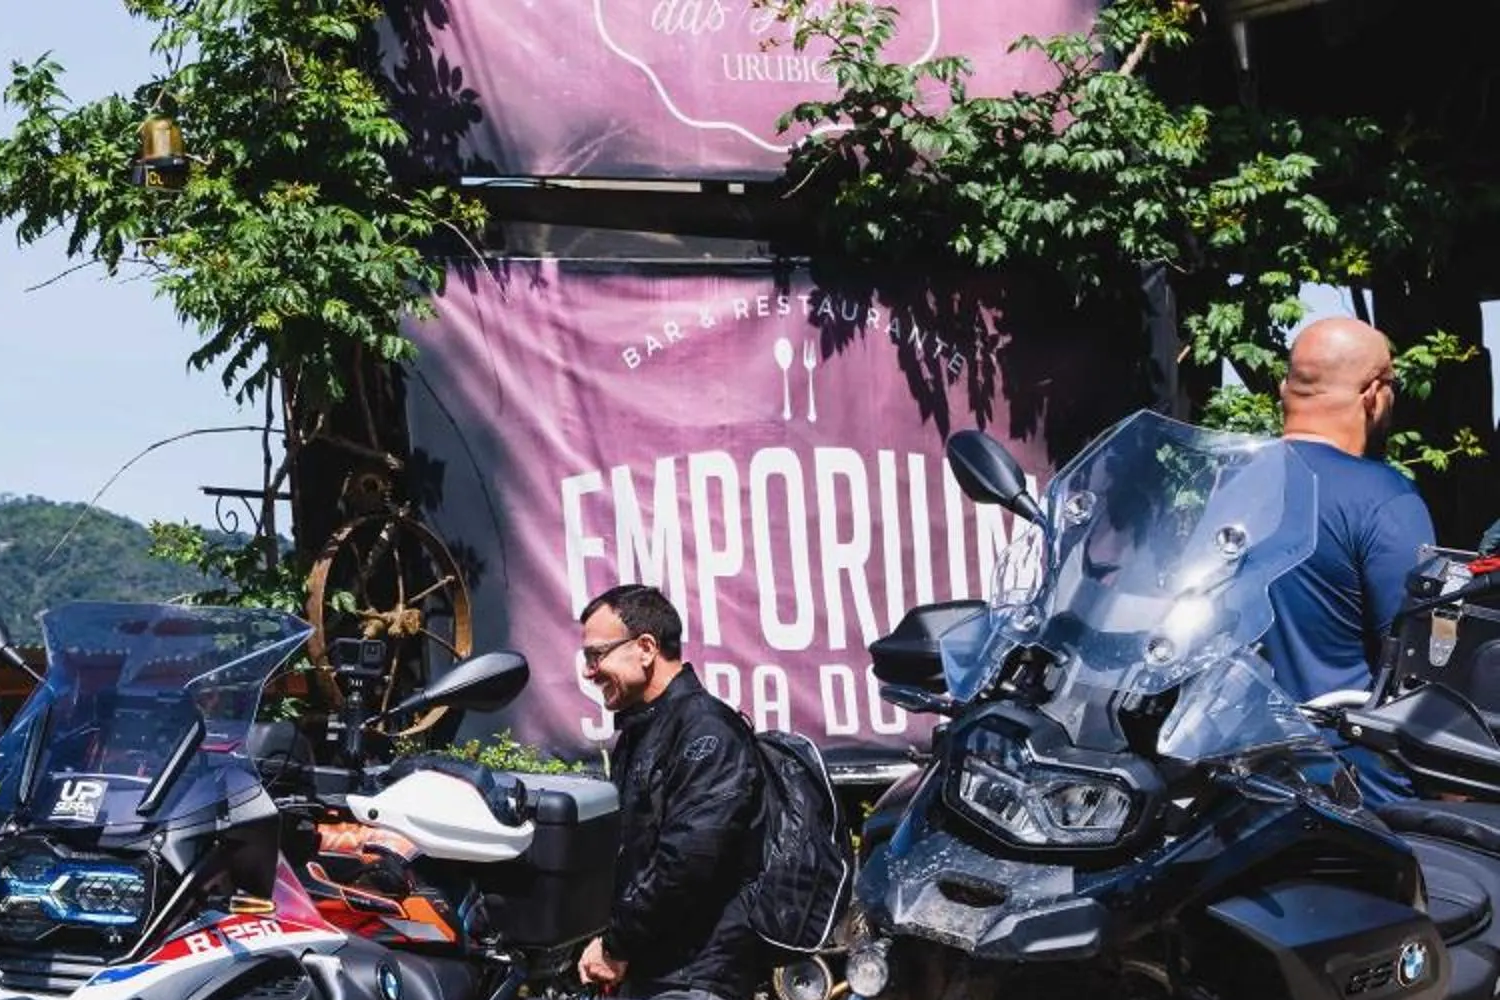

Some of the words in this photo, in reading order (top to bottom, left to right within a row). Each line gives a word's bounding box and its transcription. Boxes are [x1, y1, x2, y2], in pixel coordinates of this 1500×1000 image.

[722, 53, 838, 83] URUBIC
[622, 319, 685, 369] BAR
[700, 302, 717, 329] &
[733, 294, 967, 377] RESTAURANTE
[184, 930, 213, 956] R
